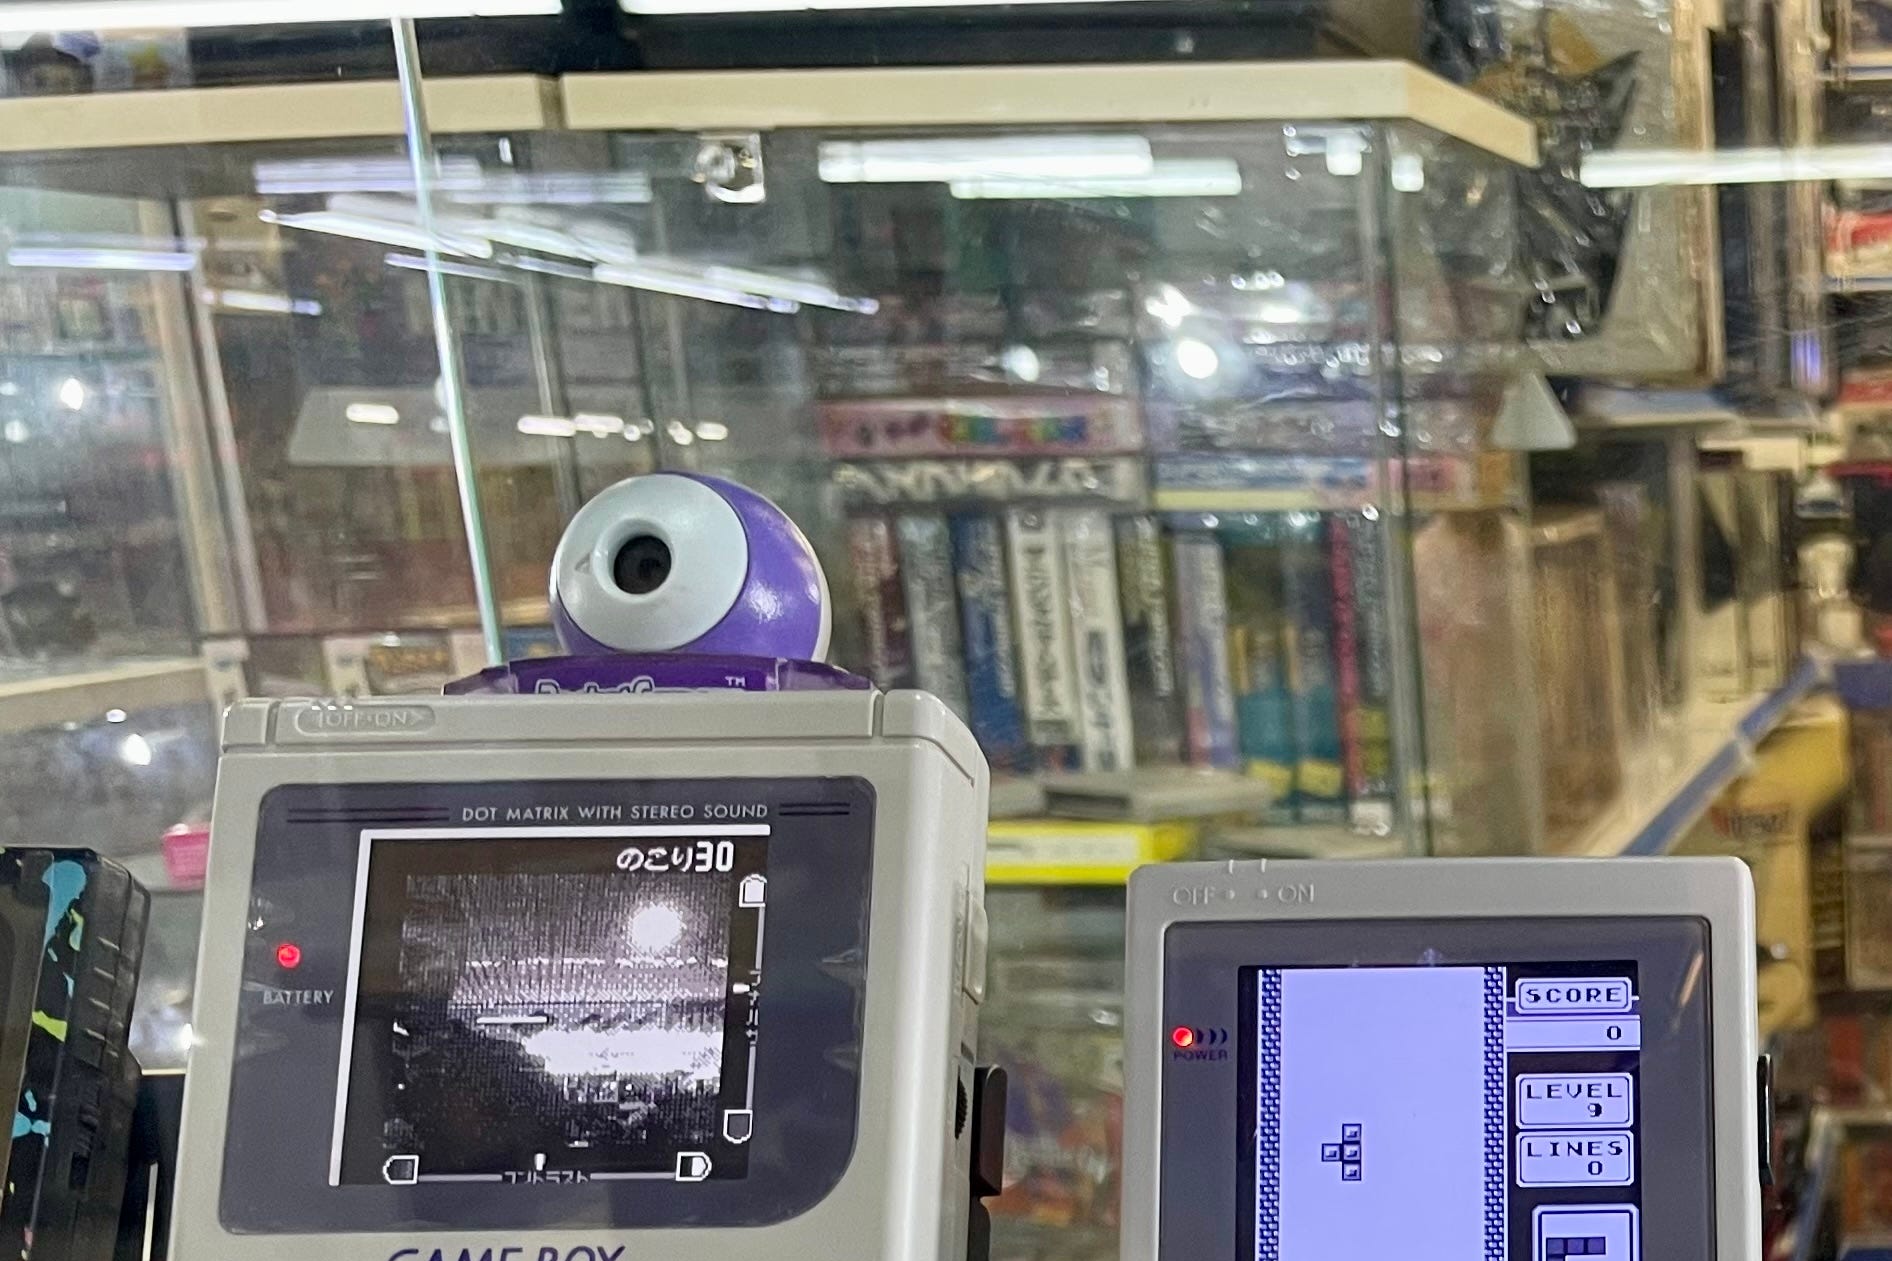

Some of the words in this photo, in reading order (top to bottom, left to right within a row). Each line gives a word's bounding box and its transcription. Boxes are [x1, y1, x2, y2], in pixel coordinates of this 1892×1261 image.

[462, 807, 497, 821] DOT
[506, 805, 569, 821] MATRIX
[578, 805, 622, 820] WITH
[630, 804, 695, 819] STEREO
[703, 803, 769, 819] SOUND
[1173, 886, 1217, 905] OFF
[1278, 883, 1314, 903] ON
[263, 989, 334, 1005] BATTERY
[1525, 988, 1622, 1003] SCORE
[1606, 1025, 1622, 1041] 0
[1173, 1049, 1228, 1061] POWER
[1526, 1083, 1623, 1099] LEVEL
[1587, 1103, 1603, 1118] 9
[1526, 1141, 1623, 1157] LINES
[1587, 1161, 1603, 1176] 0
